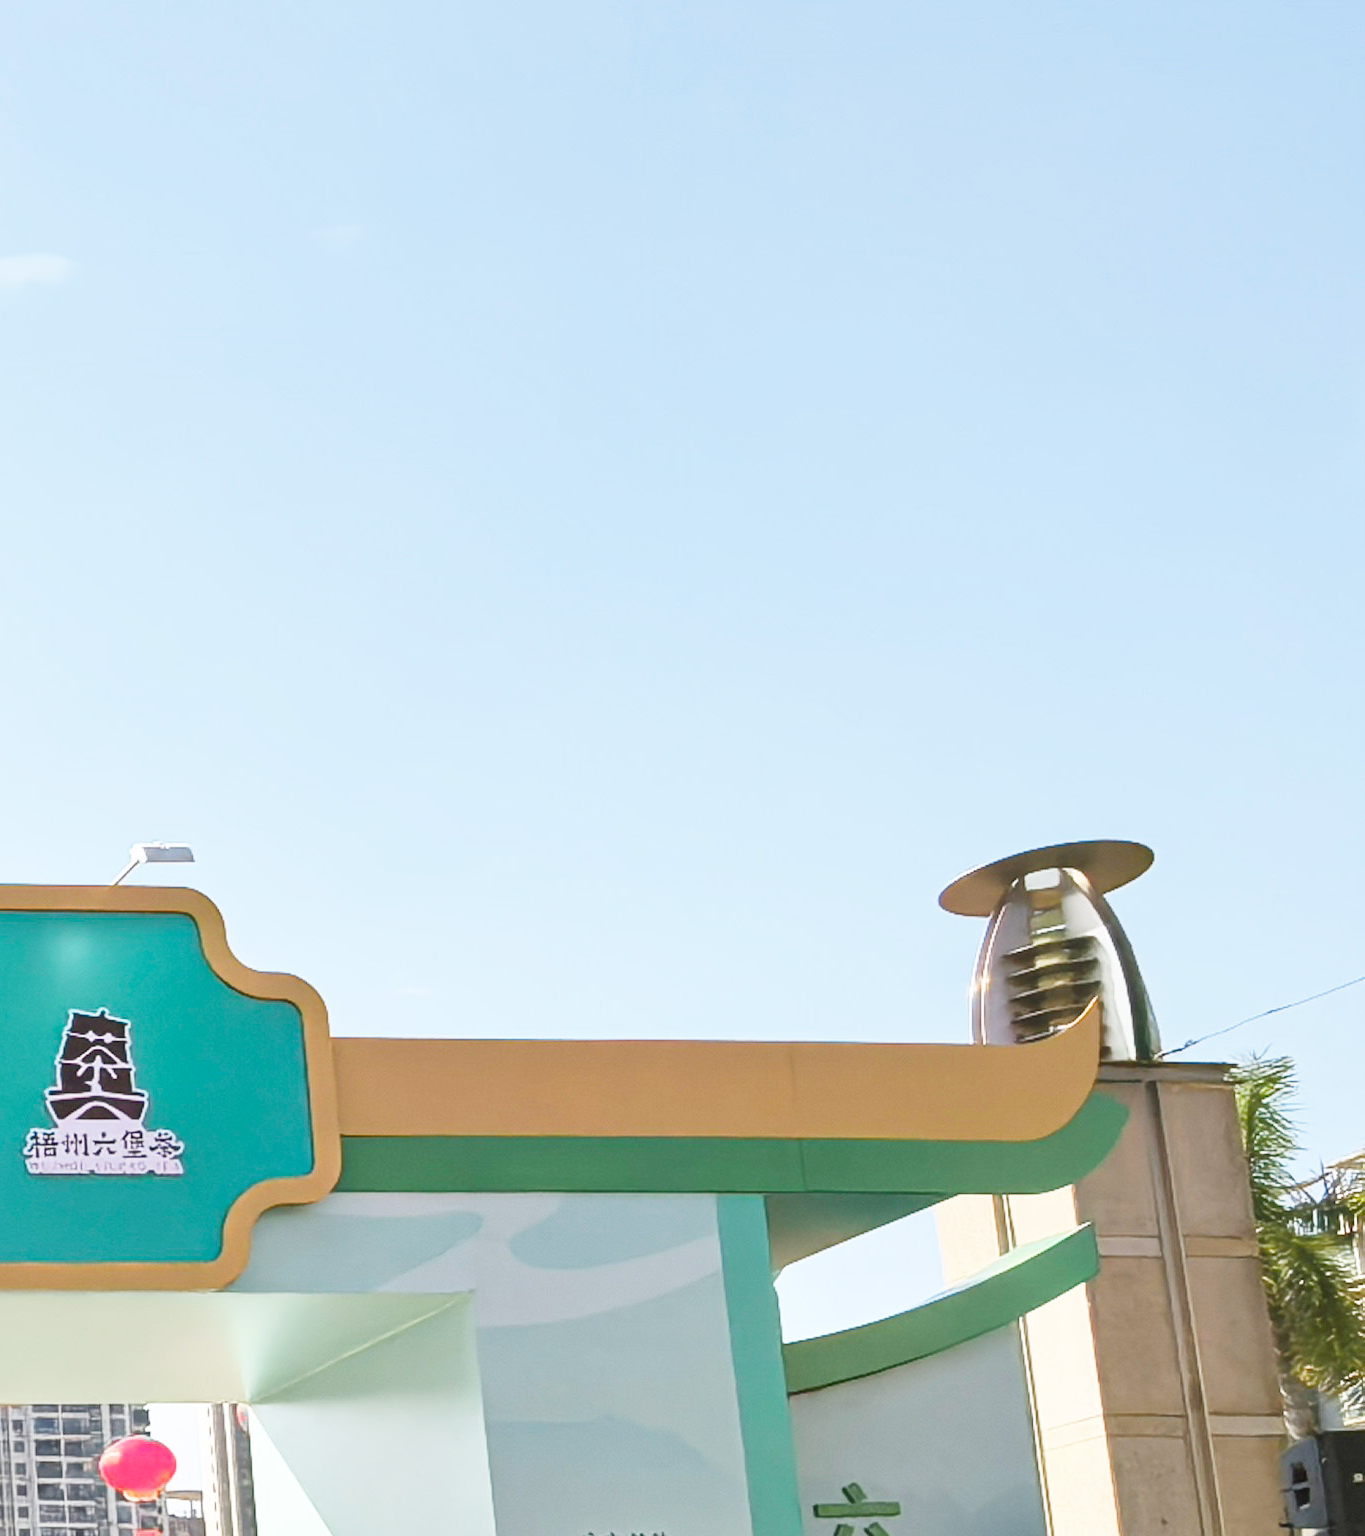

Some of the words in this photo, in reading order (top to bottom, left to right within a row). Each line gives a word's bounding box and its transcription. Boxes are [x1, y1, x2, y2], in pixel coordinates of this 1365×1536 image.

[31, 1130, 181, 1159] 梧州六堡茶
